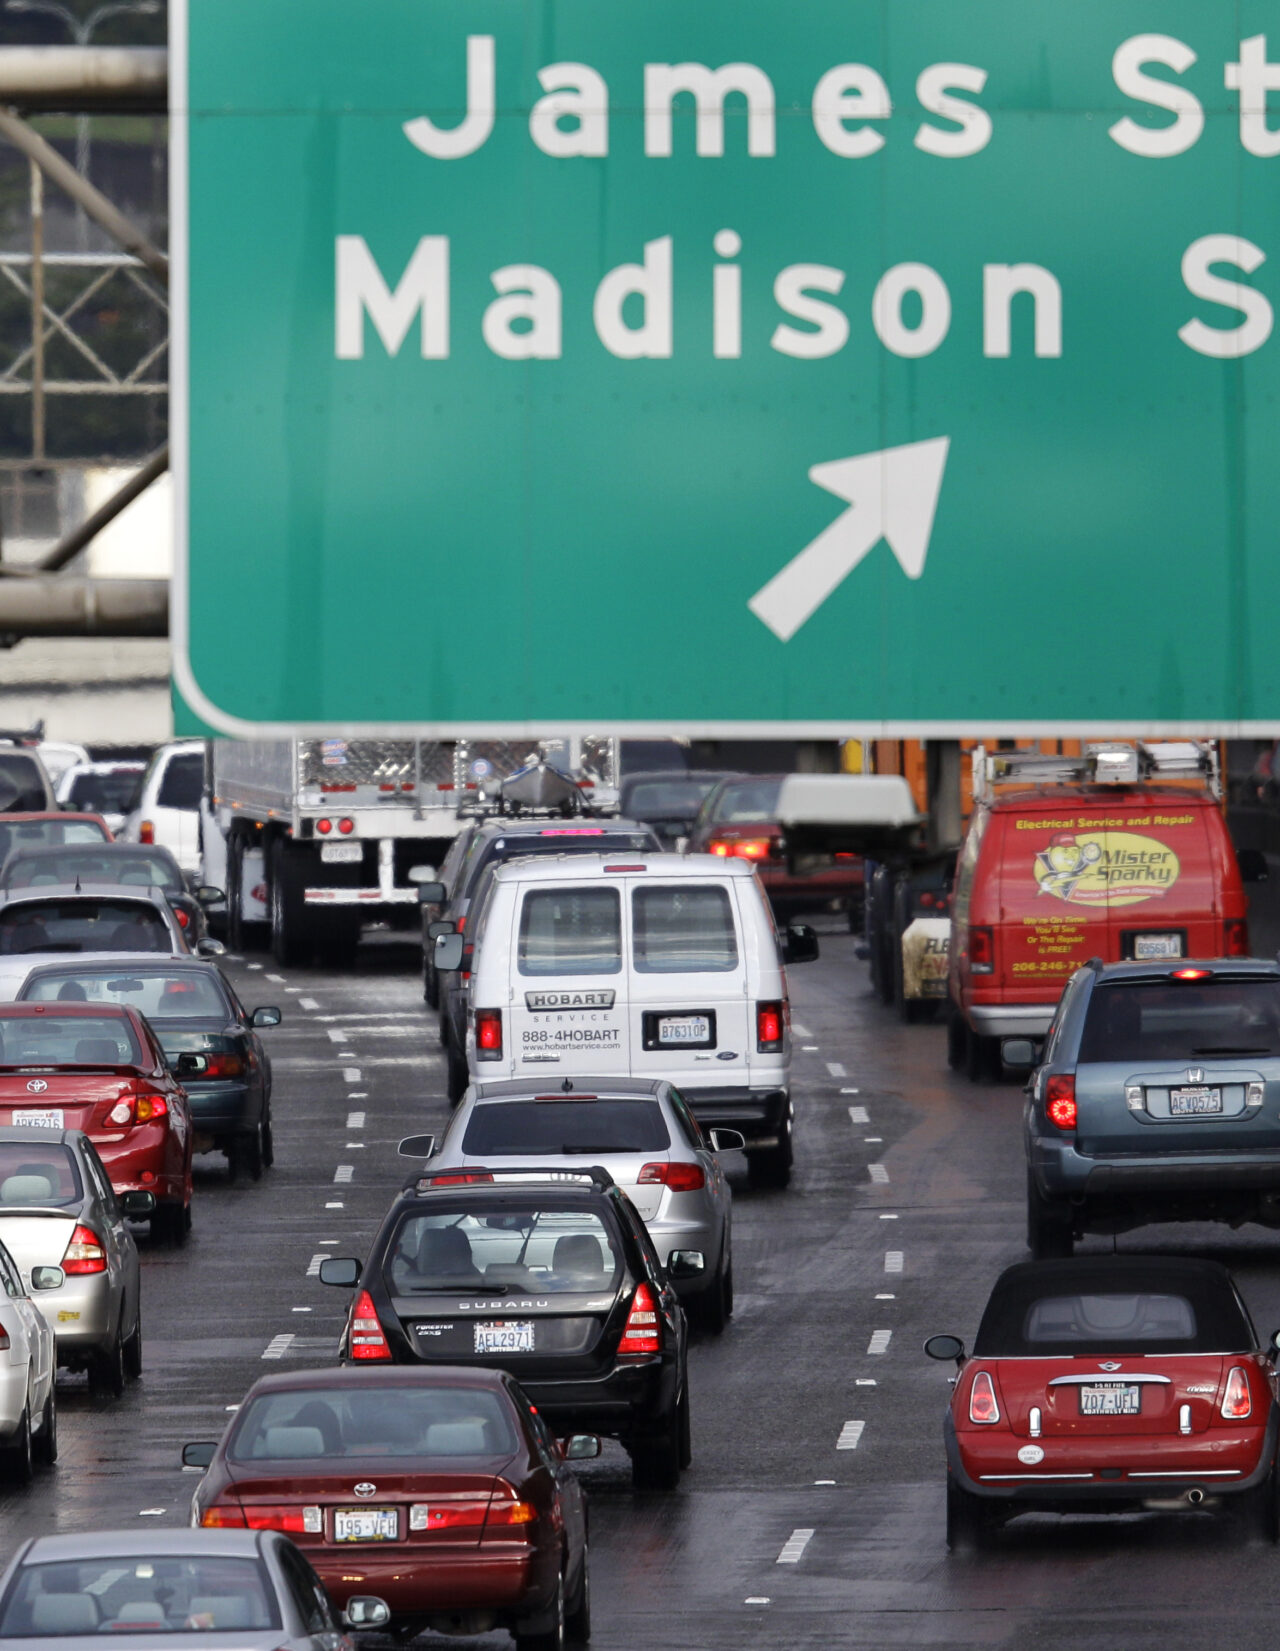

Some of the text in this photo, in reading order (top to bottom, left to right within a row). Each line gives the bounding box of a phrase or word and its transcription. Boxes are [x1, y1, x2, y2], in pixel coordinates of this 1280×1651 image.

[401, 33, 1280, 160] James St
[334, 229, 1062, 360] Madison
[1016, 815, 1194, 830] Electrical Service and Repair
[1101, 850, 1171, 865] Mister
[1096, 864, 1171, 884] Sparky
[1012, 961, 1083, 971] 206-246-71
[534, 993, 608, 1006] HOBART
[533, 1014, 609, 1023] SERVICE
[522, 1029, 620, 1042] 888-4HOBART
[522, 1041, 620, 1051] www.hobartservice.com
[459, 1300, 548, 1309] SUBARU
[478, 1332, 529, 1347] AEL2971
